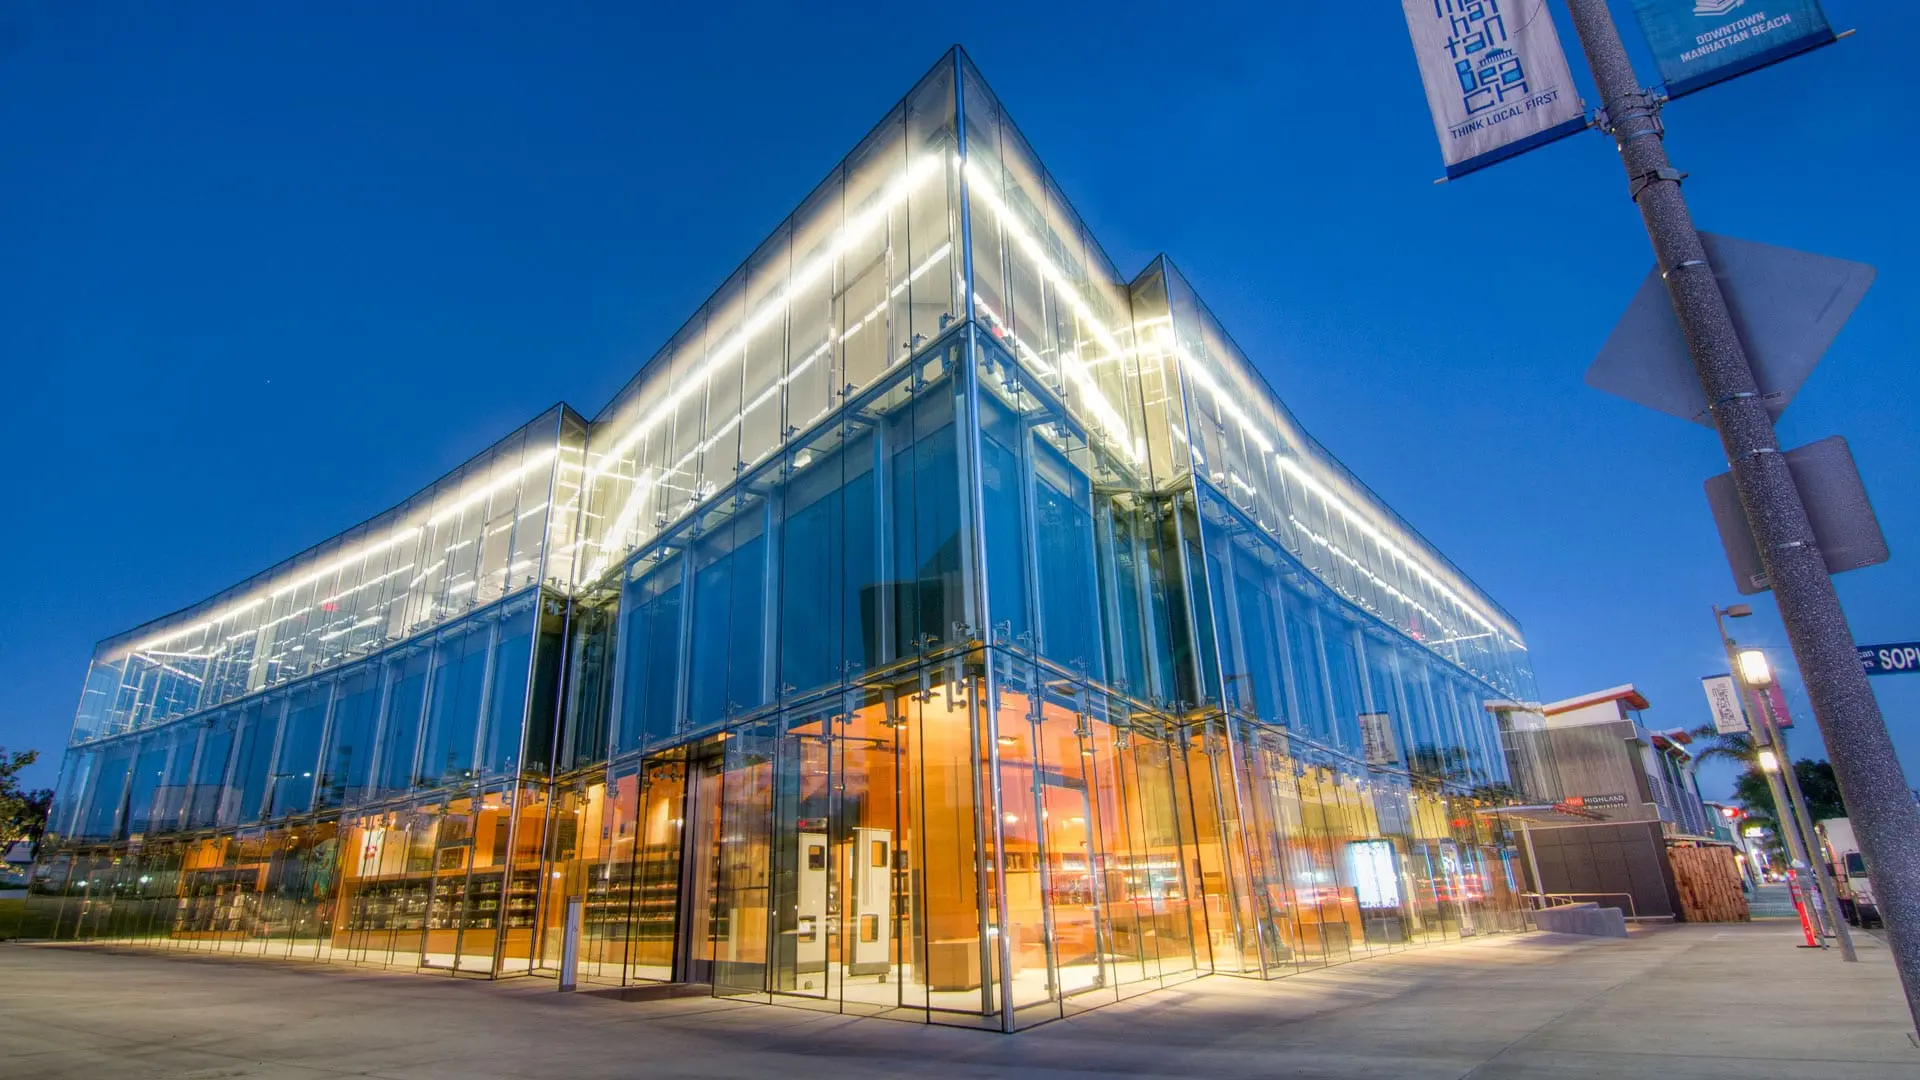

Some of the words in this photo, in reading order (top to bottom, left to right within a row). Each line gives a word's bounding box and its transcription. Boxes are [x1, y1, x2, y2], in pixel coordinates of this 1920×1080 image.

[1680, 32, 1750, 63] MANHATTAN
[1752, 13, 1792, 36] BEACH
[1695, 11, 1765, 45] DOWNTOWN
[1450, 119, 1485, 139] THINK
[1487, 106, 1523, 126] LOCAL
[1526, 91, 1559, 110] FIRST
[1584, 795, 1624, 803] HIGHLAND
